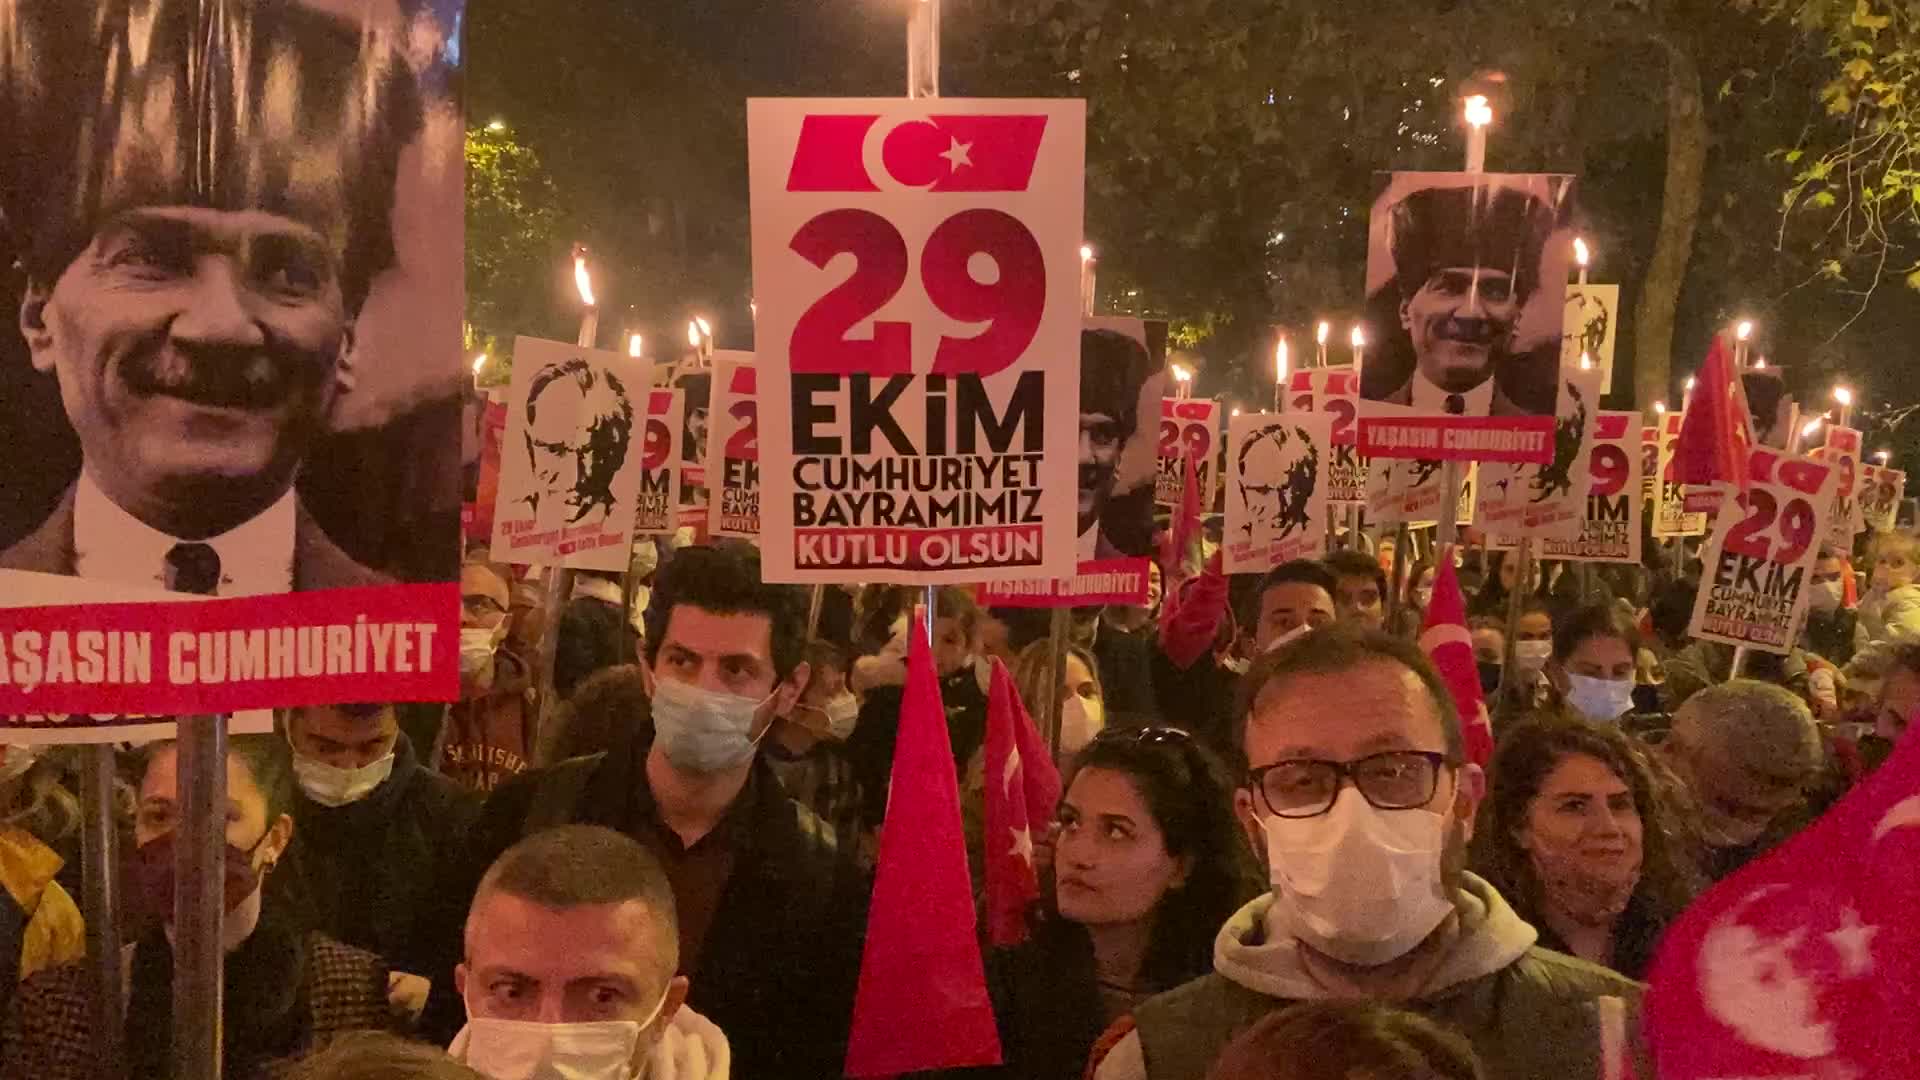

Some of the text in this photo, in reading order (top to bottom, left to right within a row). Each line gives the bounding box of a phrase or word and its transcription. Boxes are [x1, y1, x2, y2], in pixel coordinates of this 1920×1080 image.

[789, 208, 1046, 379] 29
[791, 370, 1045, 456] EKİM
[792, 454, 1044, 491] CUMHURİYET
[793, 489, 1043, 527] BAYRAMIMIZ
[1721, 488, 1818, 566] 29
[798, 530, 1039, 566] KUTLU OLSUN
[1714, 549, 1804, 602] EKİM
[168, 613, 438, 684] CUMHURİYET
